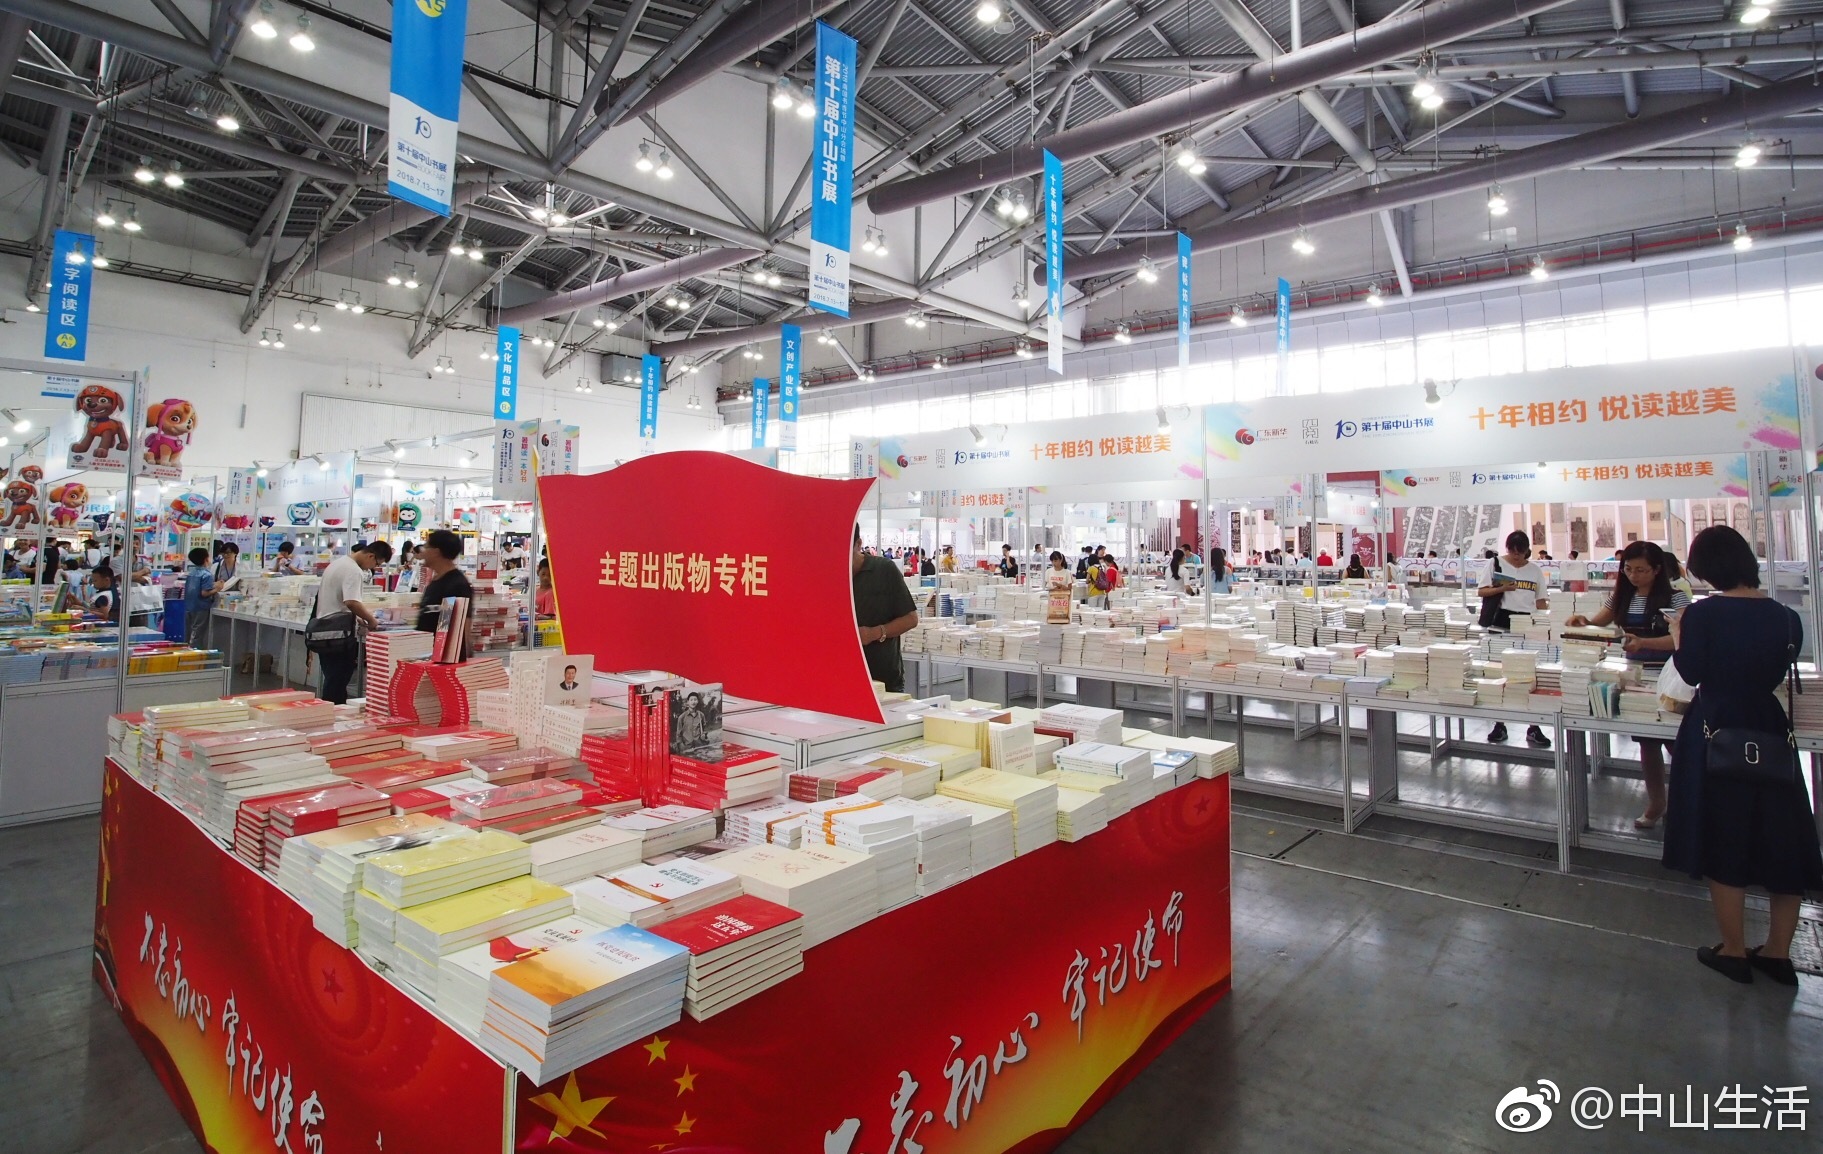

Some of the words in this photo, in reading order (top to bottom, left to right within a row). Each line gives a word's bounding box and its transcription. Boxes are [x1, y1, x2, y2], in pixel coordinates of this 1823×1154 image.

[821, 55, 841, 204] 第十届中山书展
[397, 141, 447, 173] 第十届中山书展
[502, 341, 513, 397] 文化用品区
[785, 339, 795, 397] 文创产业区
[1361, 417, 1434, 432] 第十届中山书展
[1469, 399, 1587, 430] 十年相约
[1598, 387, 1737, 421] 悦读越美
[1029, 438, 1093, 461] 十年相约
[1098, 434, 1171, 456] 悦读越美
[1256, 428, 1287, 438] 广东新华
[520, 436, 528, 483] 暑期读一本好书
[969, 449, 1010, 462] 第十届中山书展
[1557, 463, 1629, 481] 十年相约
[1635, 461, 1714, 478] 悦读越美
[1489, 473, 1536, 482] 第十届中山书展
[599, 550, 768, 597] 主题出版物专柜
[1062, 890, 1184, 1044] 牢记使命
